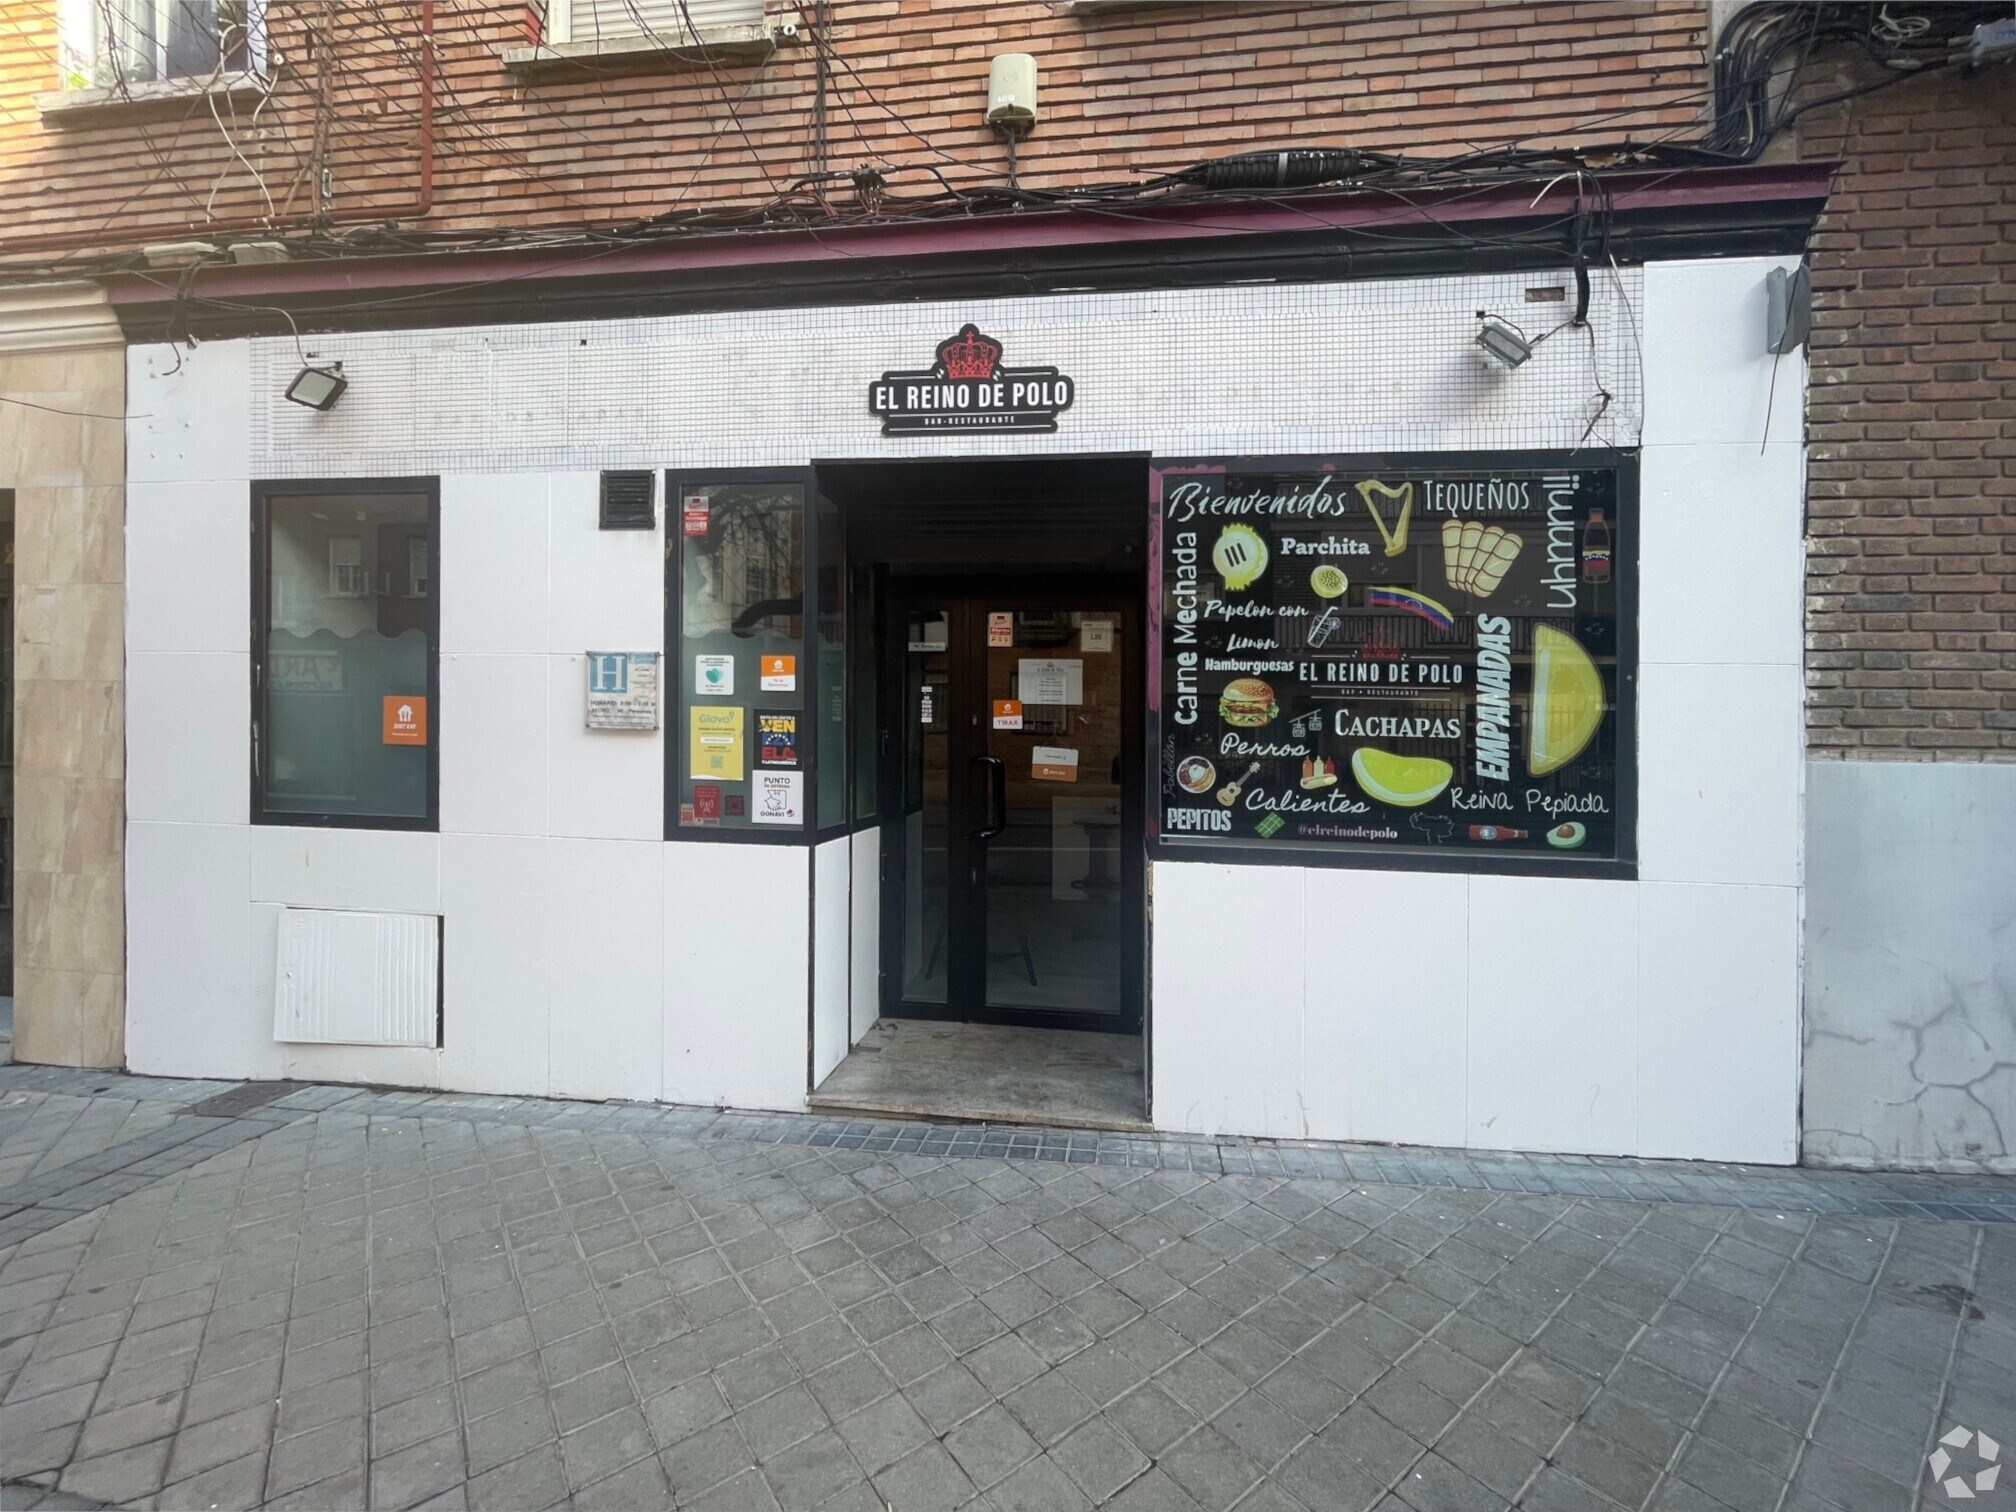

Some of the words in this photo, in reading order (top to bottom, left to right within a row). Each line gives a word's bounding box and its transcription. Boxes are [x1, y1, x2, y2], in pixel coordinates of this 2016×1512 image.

[876, 386, 899, 410] EL
[907, 384, 970, 410] REINO
[978, 383, 1004, 408] DE
[1012, 381, 1068, 406] POLO
[1168, 475, 1347, 523] Bienvenidos
[1281, 536, 1371, 556] Parchita
[1172, 531, 1197, 644] Mechada
[1203, 600, 1274, 622] Papelon
[1278, 604, 1309, 617] con
[1226, 633, 1279, 652] Limon
[593, 655, 626, 690] H
[1205, 657, 1294, 675] Hamburguesas
[1299, 662, 1318, 682] EL
[1327, 663, 1379, 682] REINO
[1388, 663, 1409, 683] DE
[1418, 664, 1463, 684] POLO
[1174, 652, 1198, 725] Carne
[1475, 613, 1512, 781] EMPANADAS
[1335, 708, 1461, 739] CACHAPAS
[1220, 732, 1311, 757] Perros
[1245, 788, 1371, 813] Calientes
[1525, 789, 1609, 820] Pepiada
[1167, 807, 1232, 831] PEPITOS
[1297, 824, 1398, 840] @elreinodepolo
